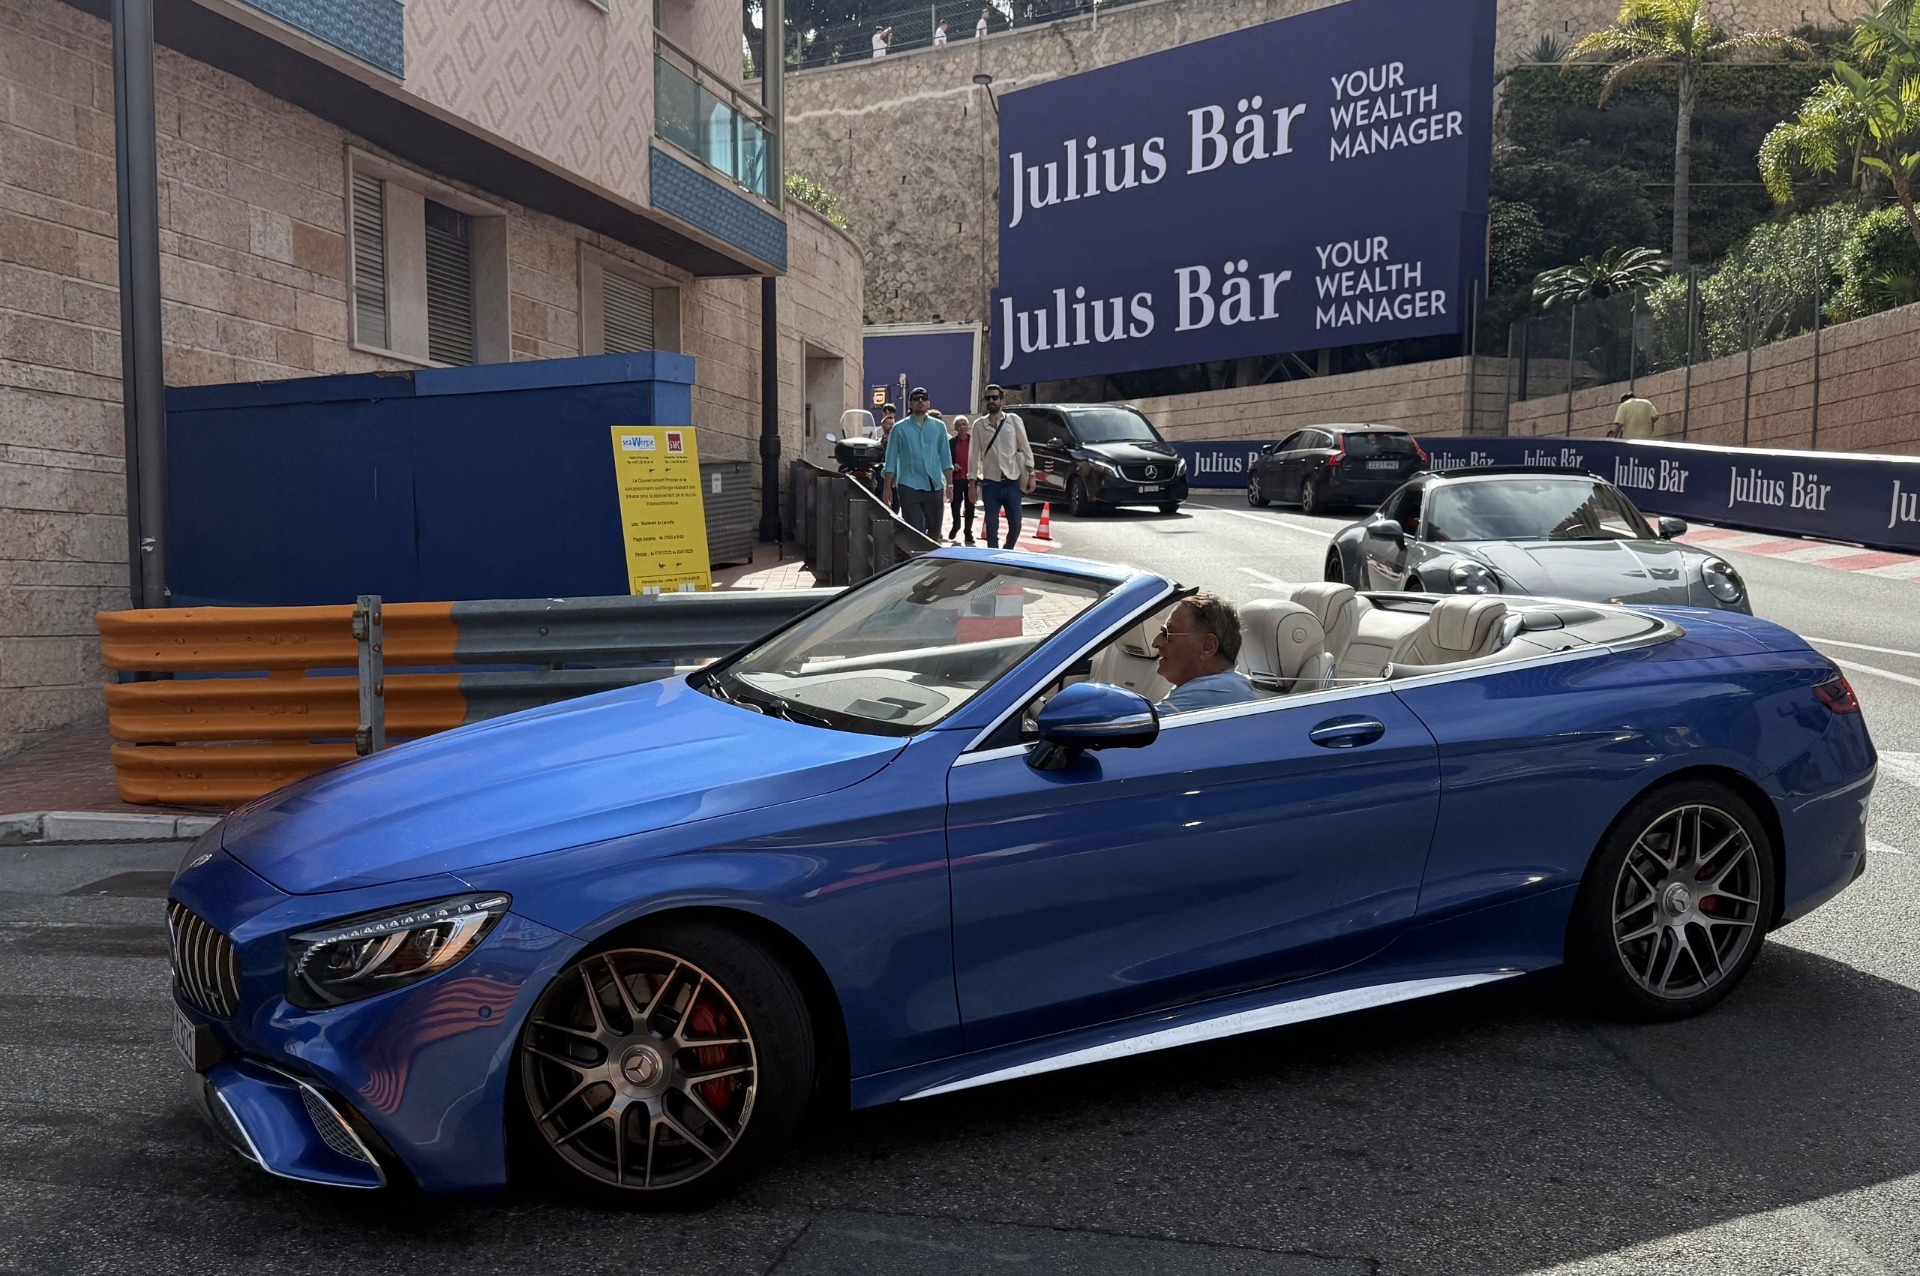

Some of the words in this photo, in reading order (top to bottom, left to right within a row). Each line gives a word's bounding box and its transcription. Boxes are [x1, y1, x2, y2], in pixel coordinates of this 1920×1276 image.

[1330, 61, 1404, 101] YOUR
[1329, 84, 1438, 129] WEALTH
[1330, 110, 1463, 162] MANAGER
[1009, 135, 1167, 228] Julius
[1187, 95, 1306, 175] Bär
[1315, 236, 1389, 270] YOUR
[1315, 261, 1422, 301] WEALTH
[999, 285, 1155, 371] Julius
[1174, 258, 1292, 333] Bär
[1315, 290, 1446, 330] MANAGER
[1194, 451, 1242, 477] Julius
[1430, 452, 1466, 469] Julius
[1523, 449, 1557, 467] Julius
[1613, 456, 1655, 487] Julius
[1658, 460, 1689, 493] Bär
[1728, 466, 1785, 508] Julius
[1790, 472, 1831, 511] Bär
